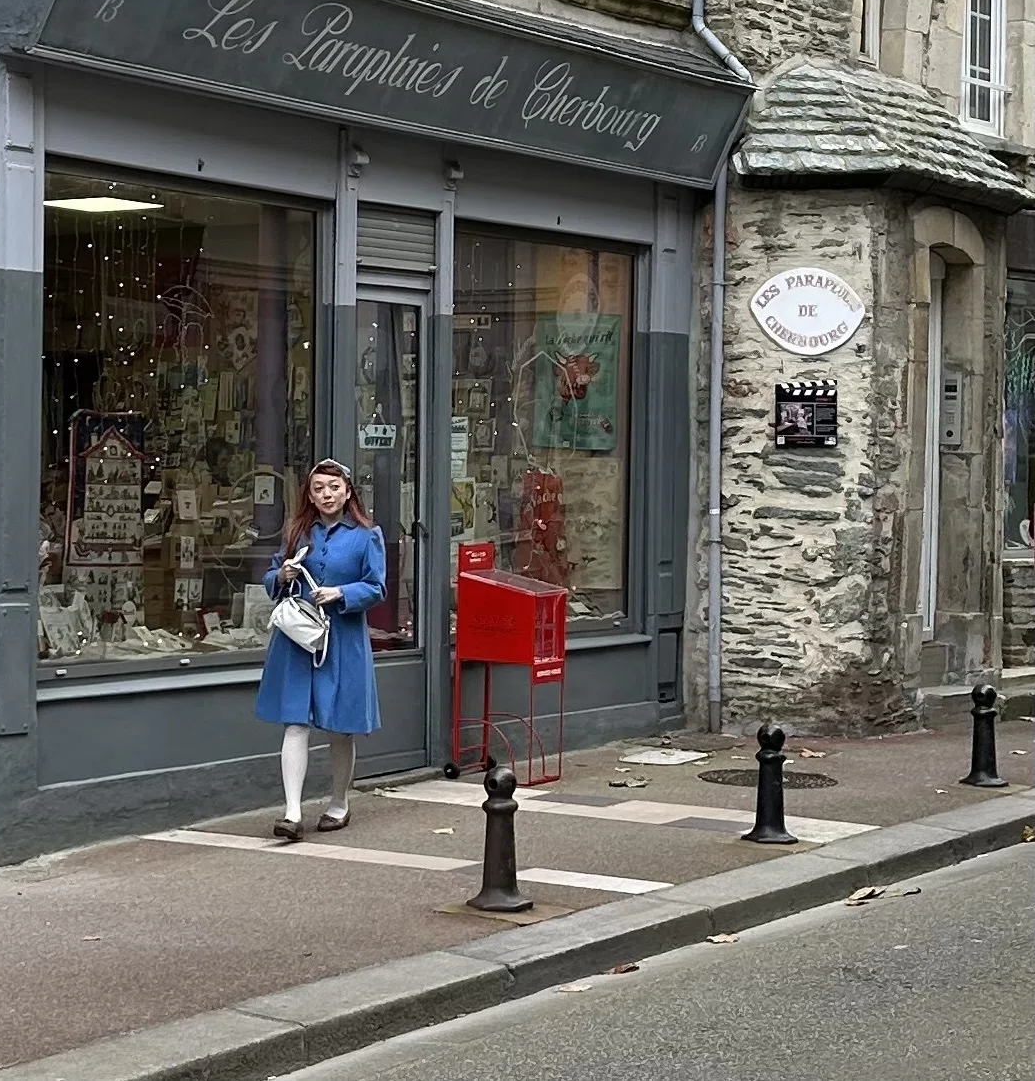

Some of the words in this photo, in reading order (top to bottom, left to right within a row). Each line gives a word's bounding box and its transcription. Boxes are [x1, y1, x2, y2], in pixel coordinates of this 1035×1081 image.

[282, 1, 464, 99] Parapluies
[469, 55, 510, 110] de
[520, 58, 663, 152] Cherbourg
[755, 284, 781, 309] LES
[797, 304, 818, 318] DE
